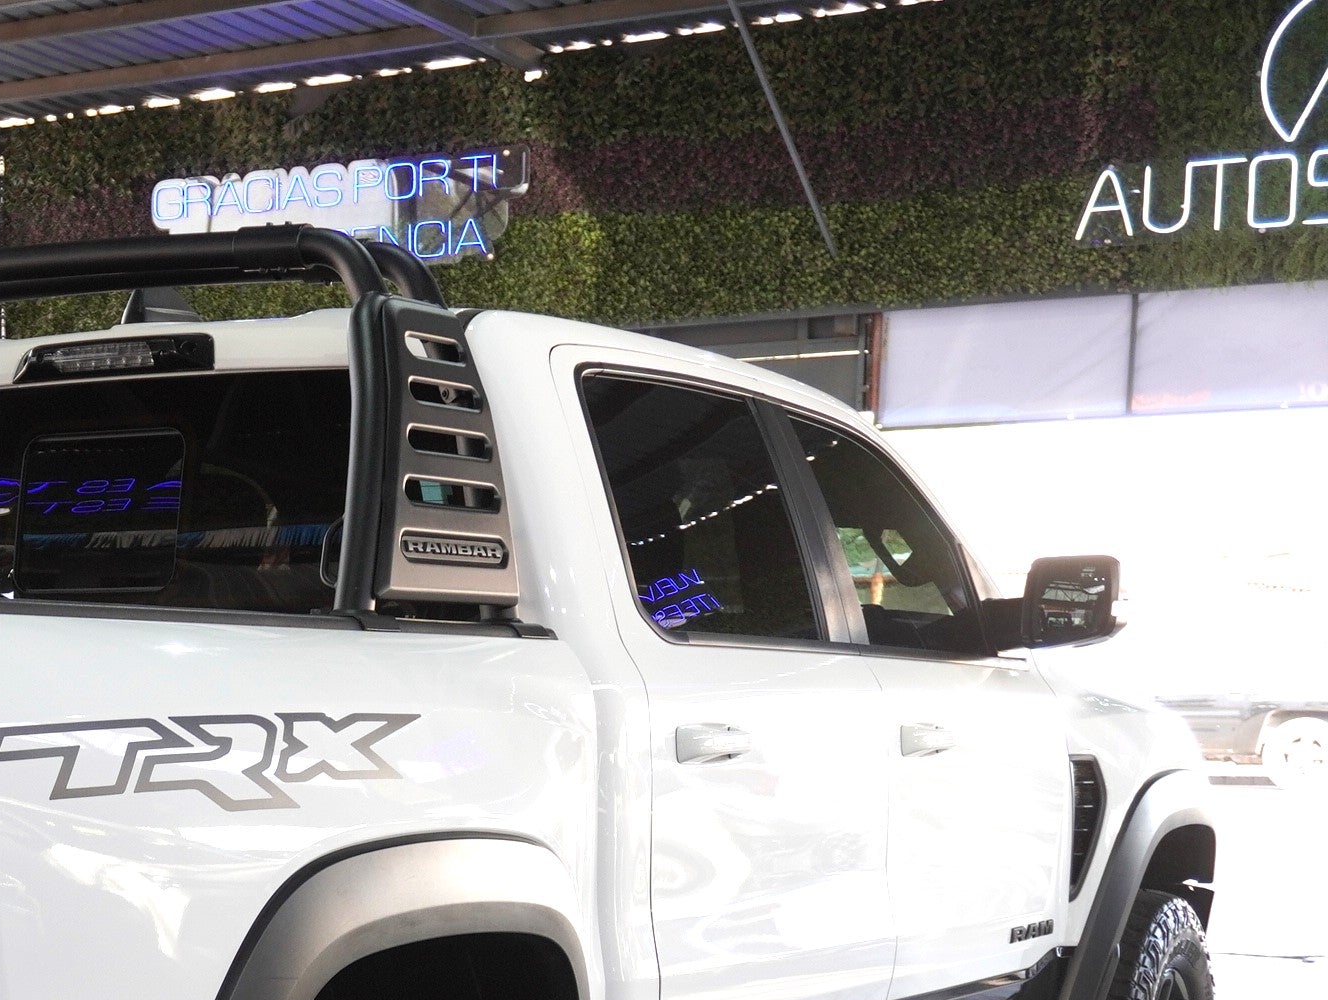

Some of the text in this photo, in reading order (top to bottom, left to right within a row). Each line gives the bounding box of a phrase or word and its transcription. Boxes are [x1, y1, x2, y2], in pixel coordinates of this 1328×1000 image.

[152, 169, 343, 221] GRACIAS
[351, 158, 451, 204] POR
[404, 540, 502, 558] RAMBAR
[1009, 918, 1054, 944] RAM
